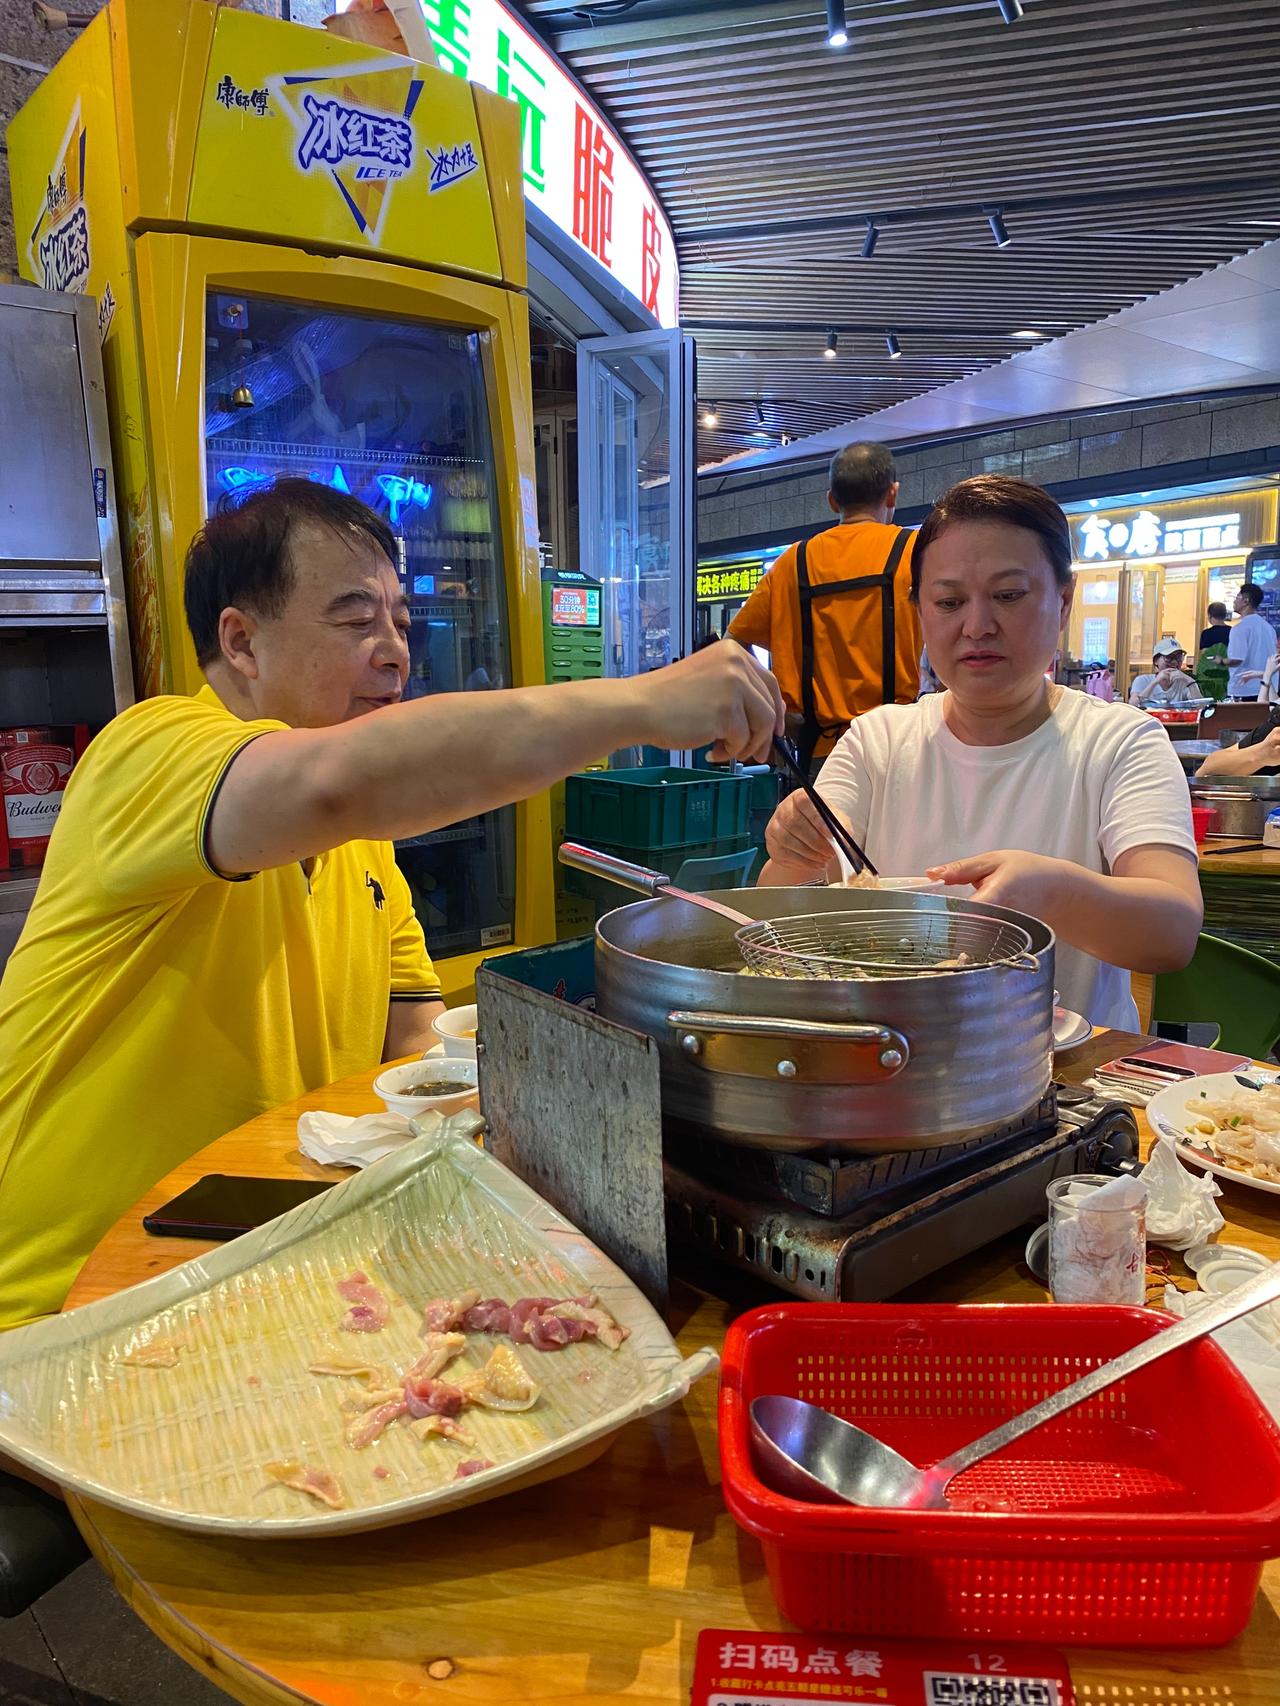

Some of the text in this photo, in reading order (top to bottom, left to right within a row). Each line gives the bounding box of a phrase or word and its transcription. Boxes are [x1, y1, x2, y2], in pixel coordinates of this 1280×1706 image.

[216, 75, 270, 116] 康師傅
[299, 95, 411, 169] 冰红茶
[356, 166, 403, 178] ICE TEA
[719, 1642, 884, 1678] 扫码点餐
[967, 1653, 1008, 1673] 12
